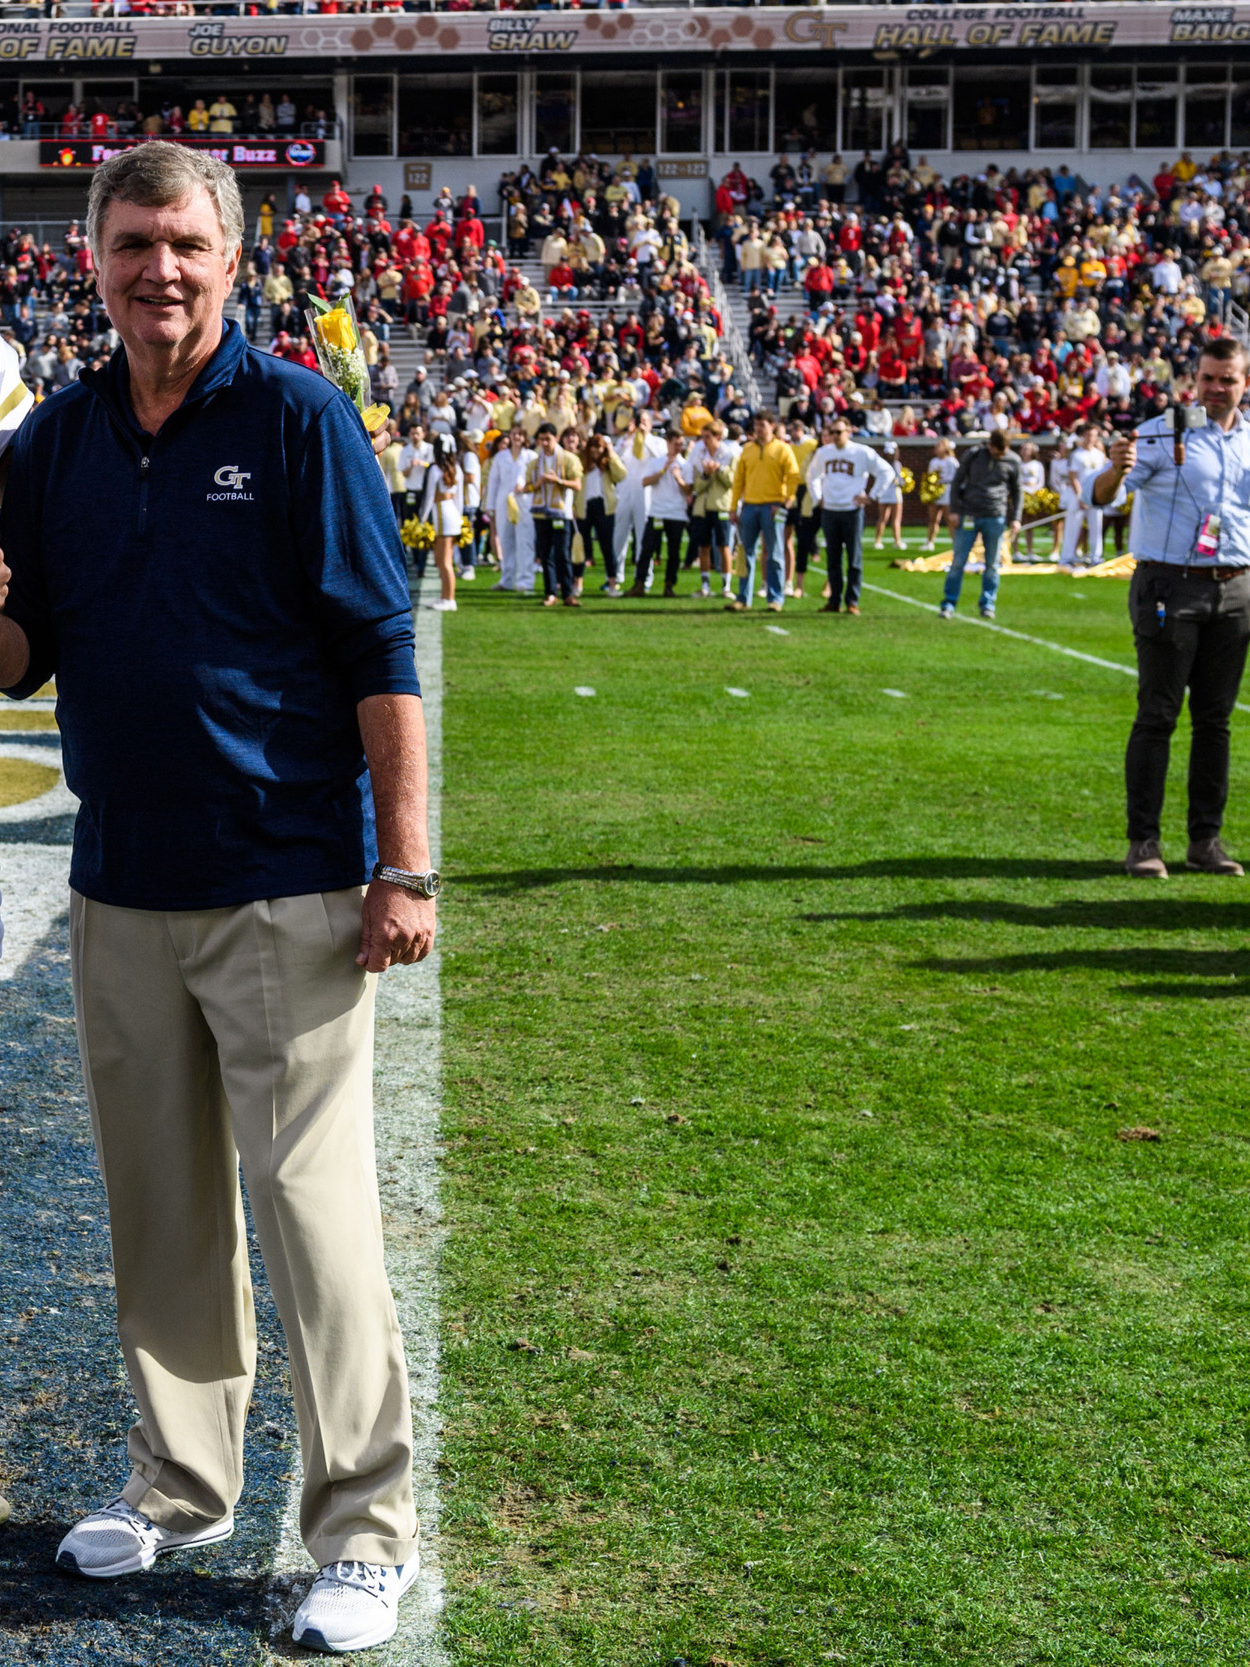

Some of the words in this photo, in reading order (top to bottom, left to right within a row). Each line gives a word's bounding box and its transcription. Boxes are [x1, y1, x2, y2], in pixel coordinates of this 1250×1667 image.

[906, 8, 987, 21] COLLEGE
[994, 7, 1085, 20] FOOTBALL
[1170, 7, 1236, 22] MAXIE
[49, 20, 134, 34] FOOTBALL
[188, 22, 225, 38] JOE
[487, 17, 540, 33] BILLY
[487, 30, 579, 51] SHAW
[872, 23, 958, 48] HALL
[966, 22, 1014, 46] OF
[1018, 21, 1118, 46] FAME
[45, 35, 138, 60] FAME
[189, 34, 289, 56] GUYON
[232, 146, 277, 162] Buzz
[824, 458, 855, 477] TECH
[206, 492, 255, 502] FOOTBALL
